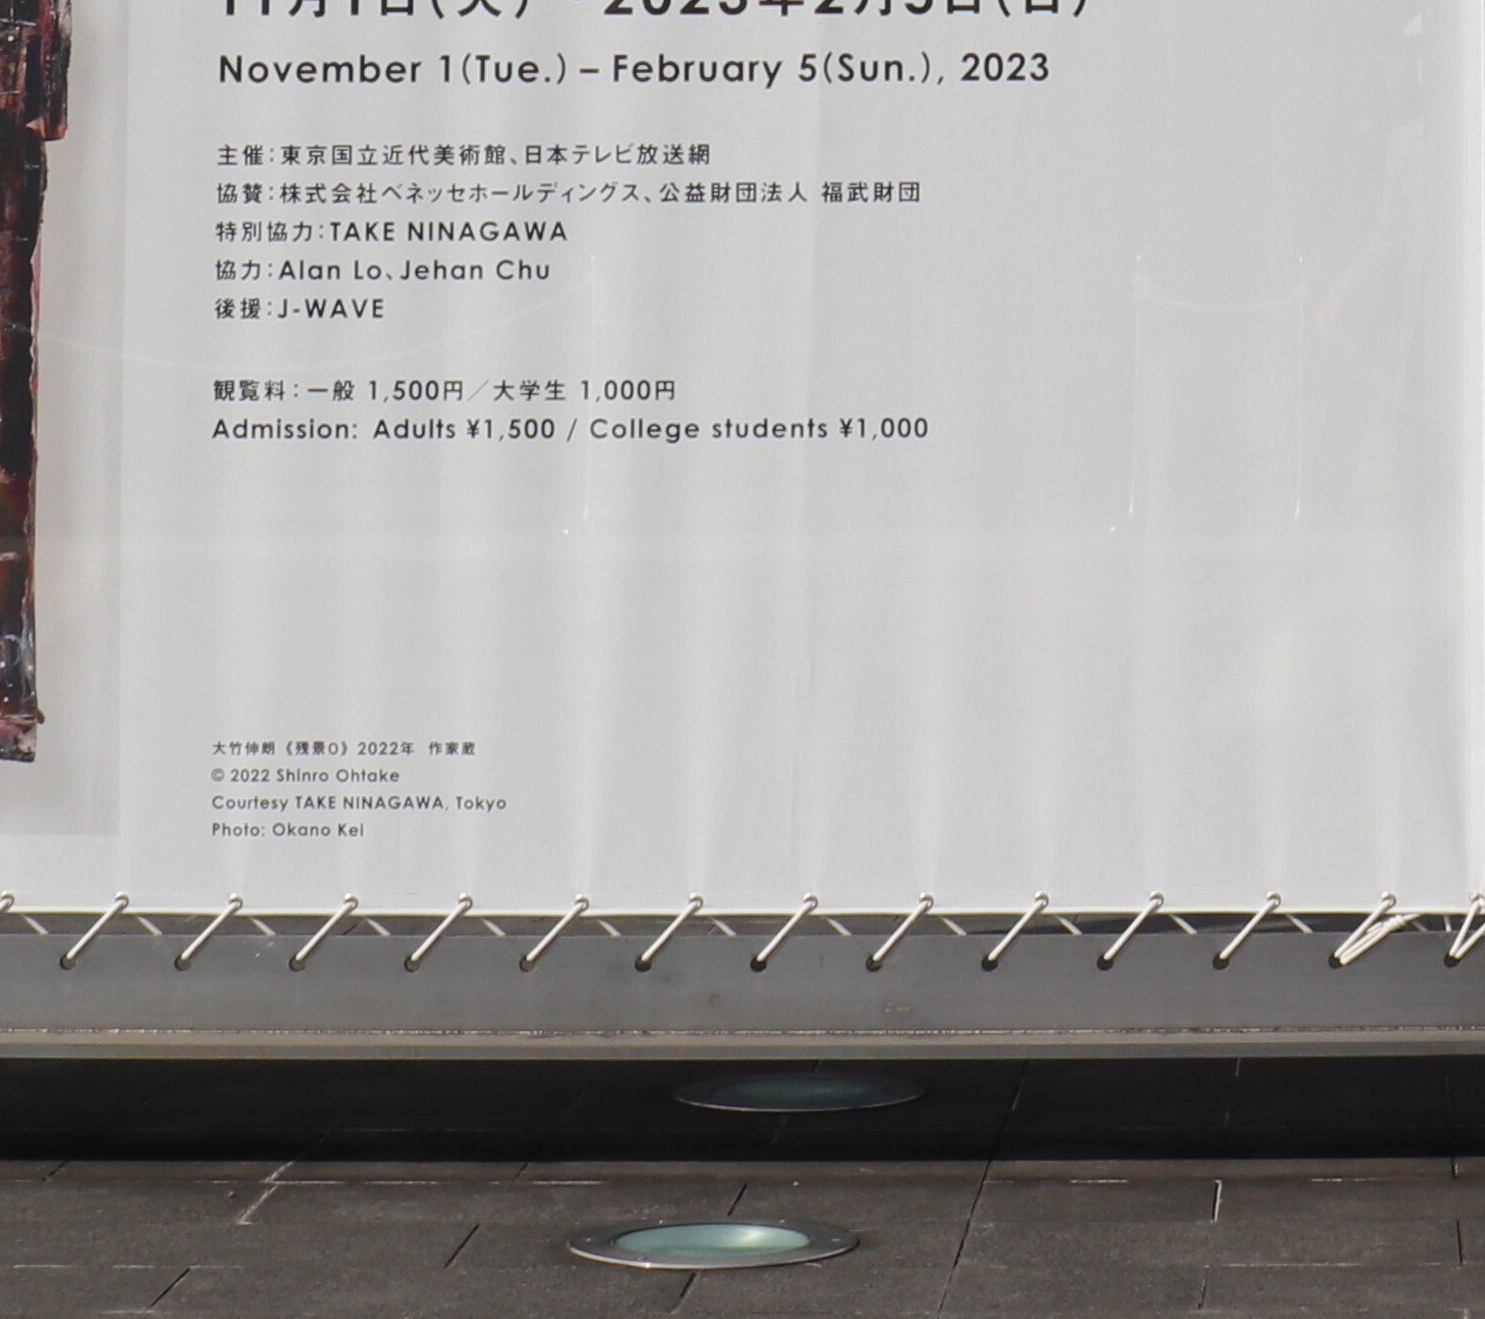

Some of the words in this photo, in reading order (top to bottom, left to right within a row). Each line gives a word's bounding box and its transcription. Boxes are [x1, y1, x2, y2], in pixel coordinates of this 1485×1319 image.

[219, 54, 422, 84] November
[613, 53, 783, 89] February
[960, 52, 1049, 82] 2023
[821, 181, 920, 203] 福武財団
[407, 221, 567, 242] NINAGAWA
[495, 259, 550, 281] Chu
[581, 379, 675, 402] 1,000円
[212, 418, 357, 440] Admission:
[373, 418, 456, 440] Adults
[467, 418, 555, 441] ¥1,500
[590, 418, 700, 444] College
[712, 417, 828, 439] students
[839, 417, 928, 440] ¥1,000
[230, 768, 270, 783] 2022
[276, 768, 330, 783] Shinro
[335, 768, 400, 783] Ohtake
[211, 795, 289, 813] Courtesy
[295, 795, 336, 810] TAKE
[343, 795, 450, 812] NINAGAWA,
[455, 795, 507, 813] Tokyo
[212, 822, 266, 837] Photo:
[272, 822, 331, 837] Okano
[337, 823, 364, 837] Kei
